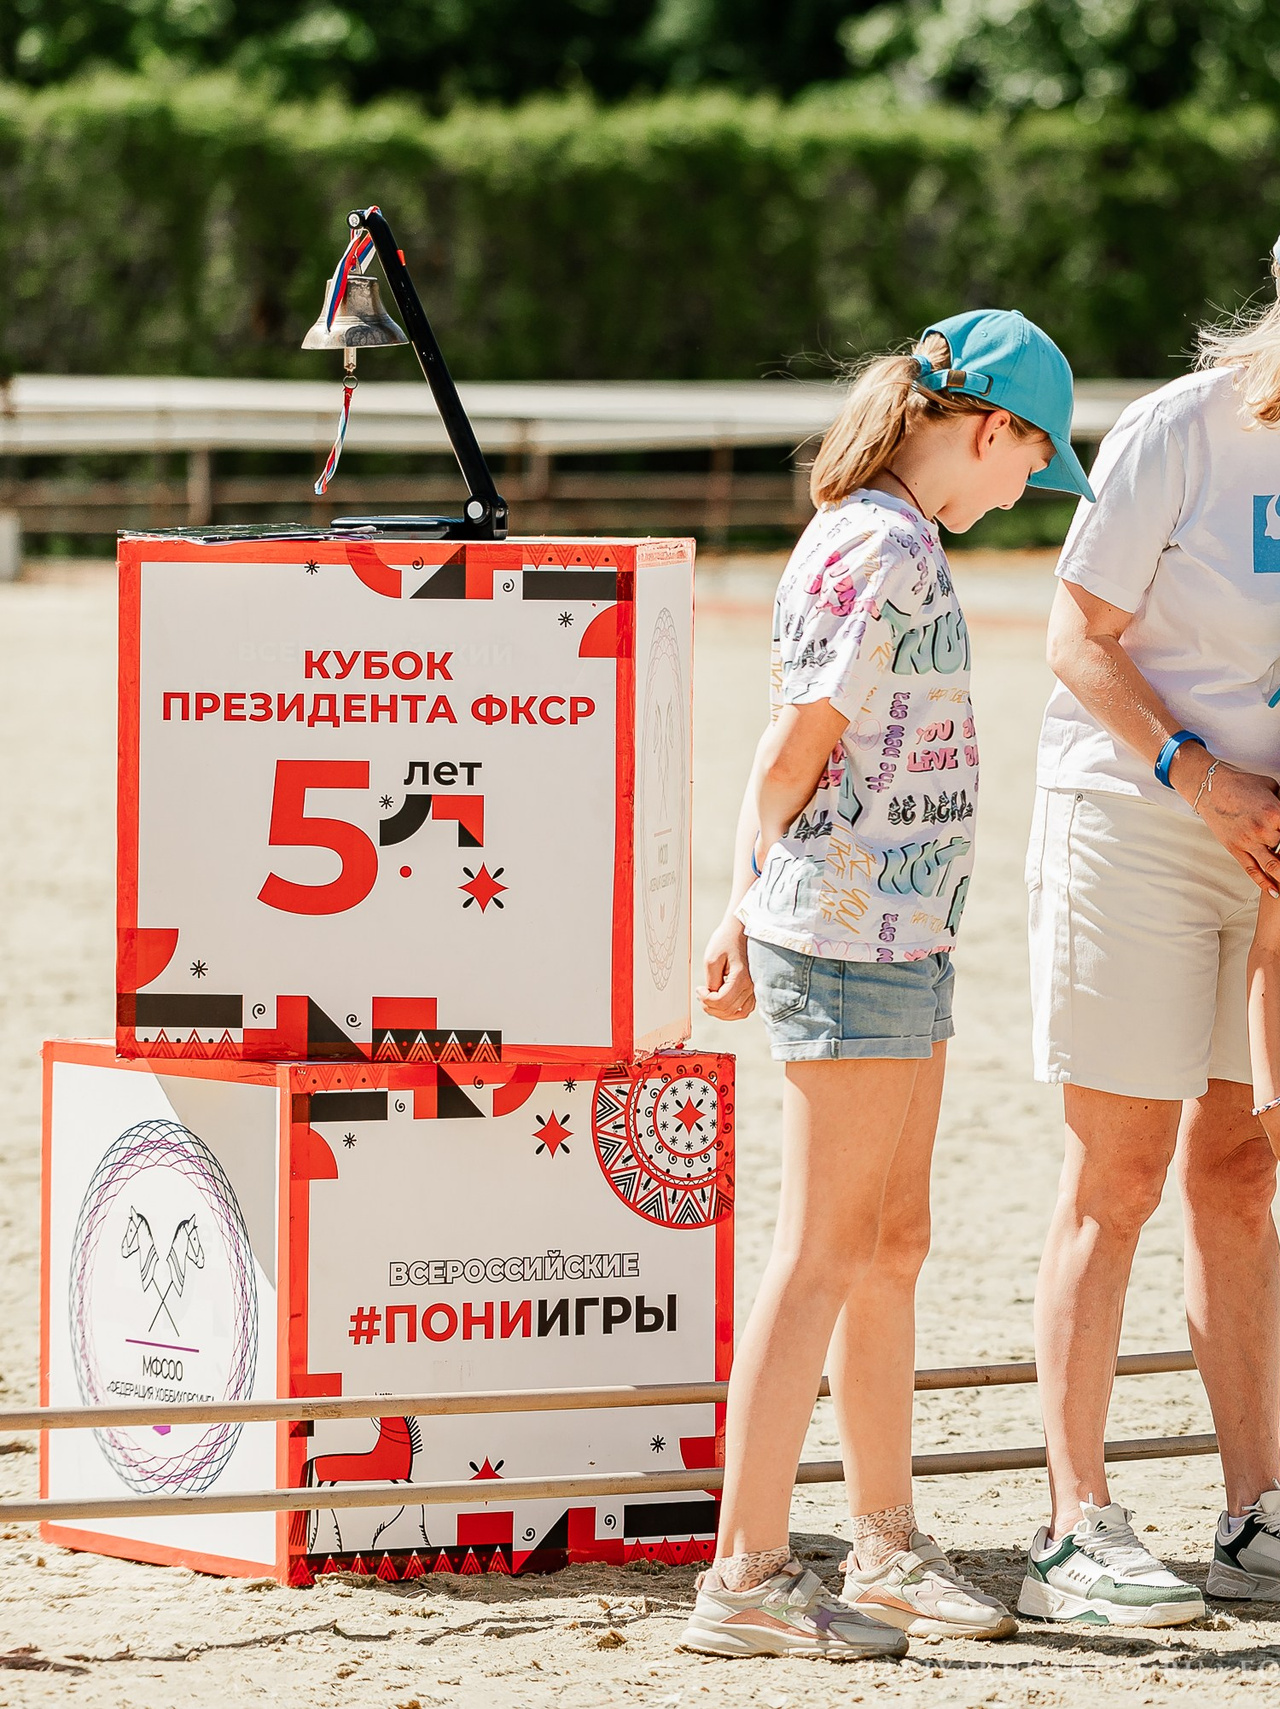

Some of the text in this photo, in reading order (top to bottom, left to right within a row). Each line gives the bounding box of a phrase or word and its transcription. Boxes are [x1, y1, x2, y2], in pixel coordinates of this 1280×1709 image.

[303, 650, 454, 681] КУБОК
[162, 692, 597, 728] ПРЕЗИДЕНТА ФКСР
[865, 692, 911, 793] the new era
[915, 719, 954, 744] YOU
[906, 747, 959, 773] LIVE
[888, 794, 917, 826] BE
[257, 759, 483, 916] 5 лет
[878, 836, 972, 898] NOT
[834, 887, 871, 934] YOU
[878, 913, 899, 943] era
[389, 1250, 640, 1286] ВСЕРОССИЙСКИЕ
[348, 1294, 678, 1345] #ПОНИИГРЫ
[142, 1355, 184, 1381] МФСОО
